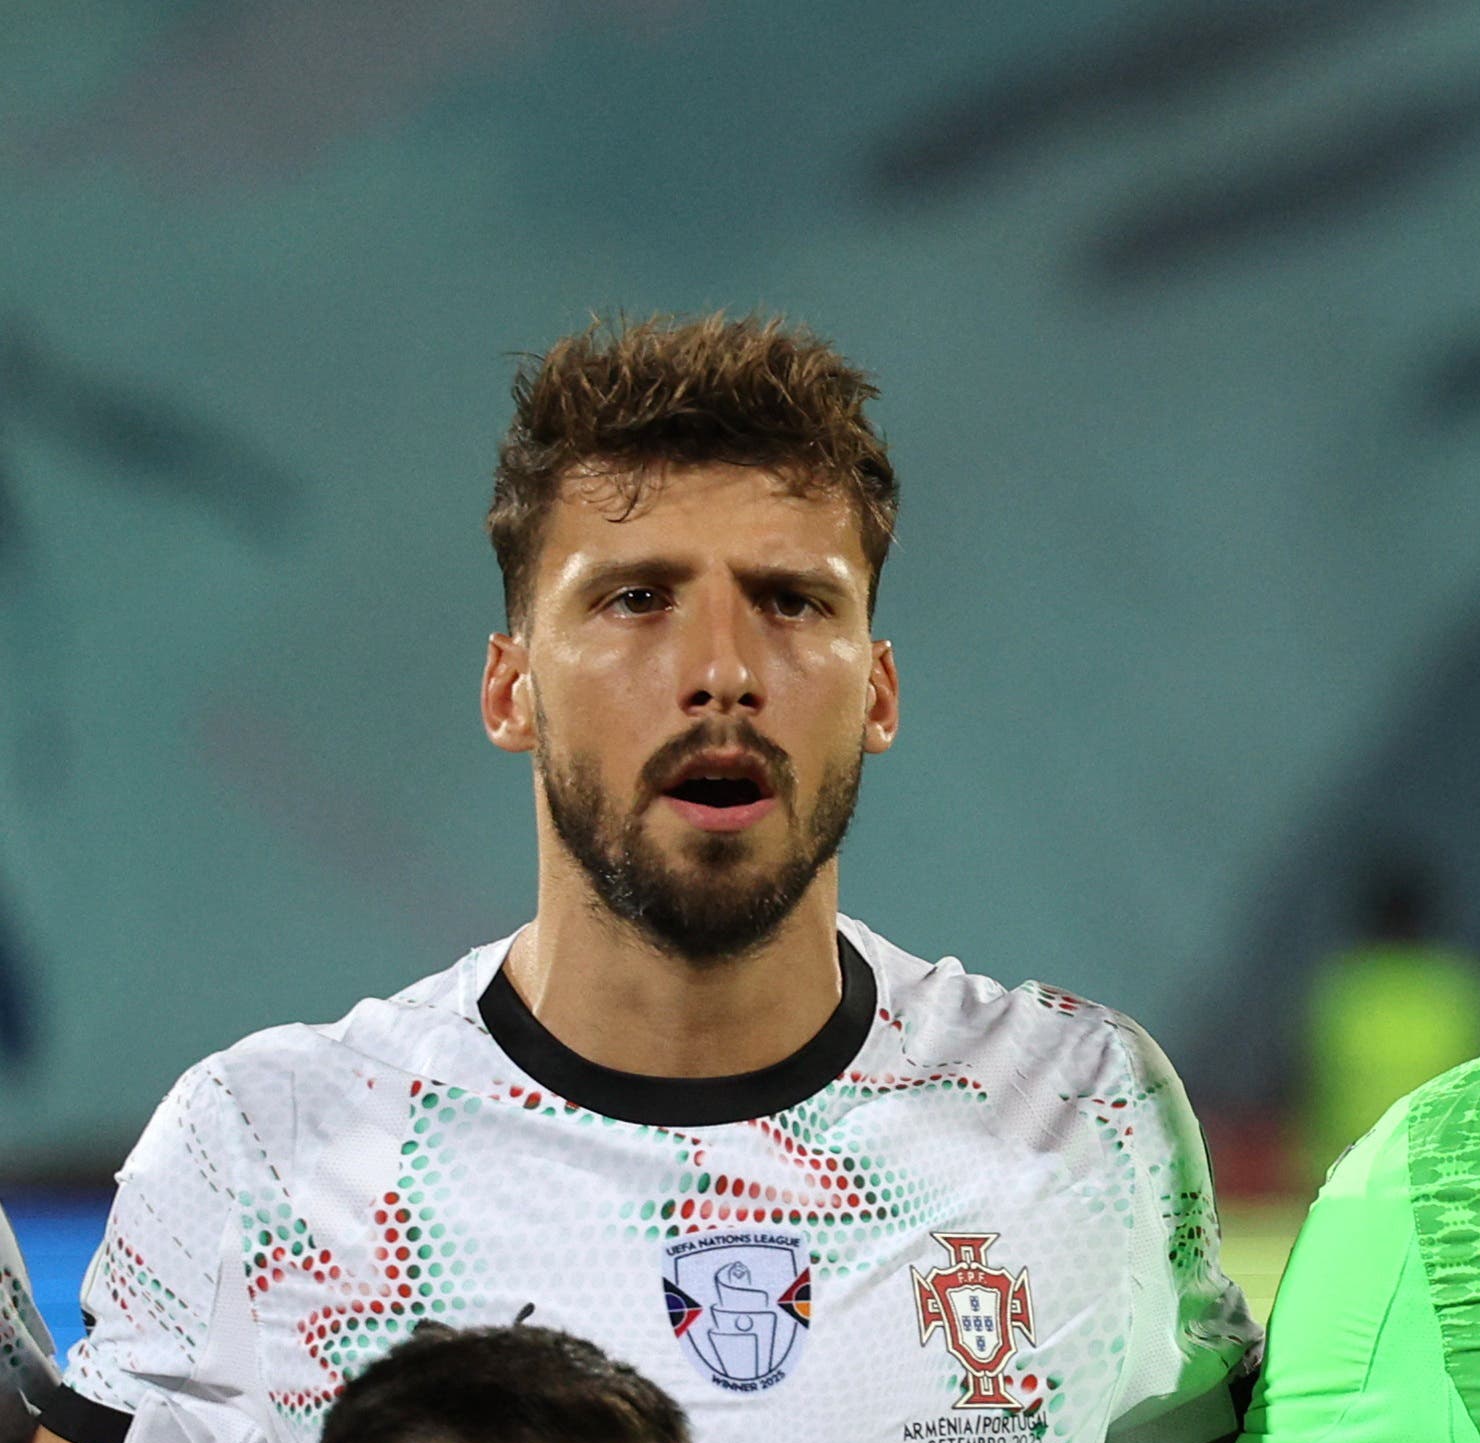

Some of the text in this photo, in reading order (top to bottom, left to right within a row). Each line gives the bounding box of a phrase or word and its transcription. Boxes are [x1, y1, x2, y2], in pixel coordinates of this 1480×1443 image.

[667, 1234, 800, 1256] UEFA NATIONS LEAGUE
[712, 1369, 785, 1392] WINNER 2025
